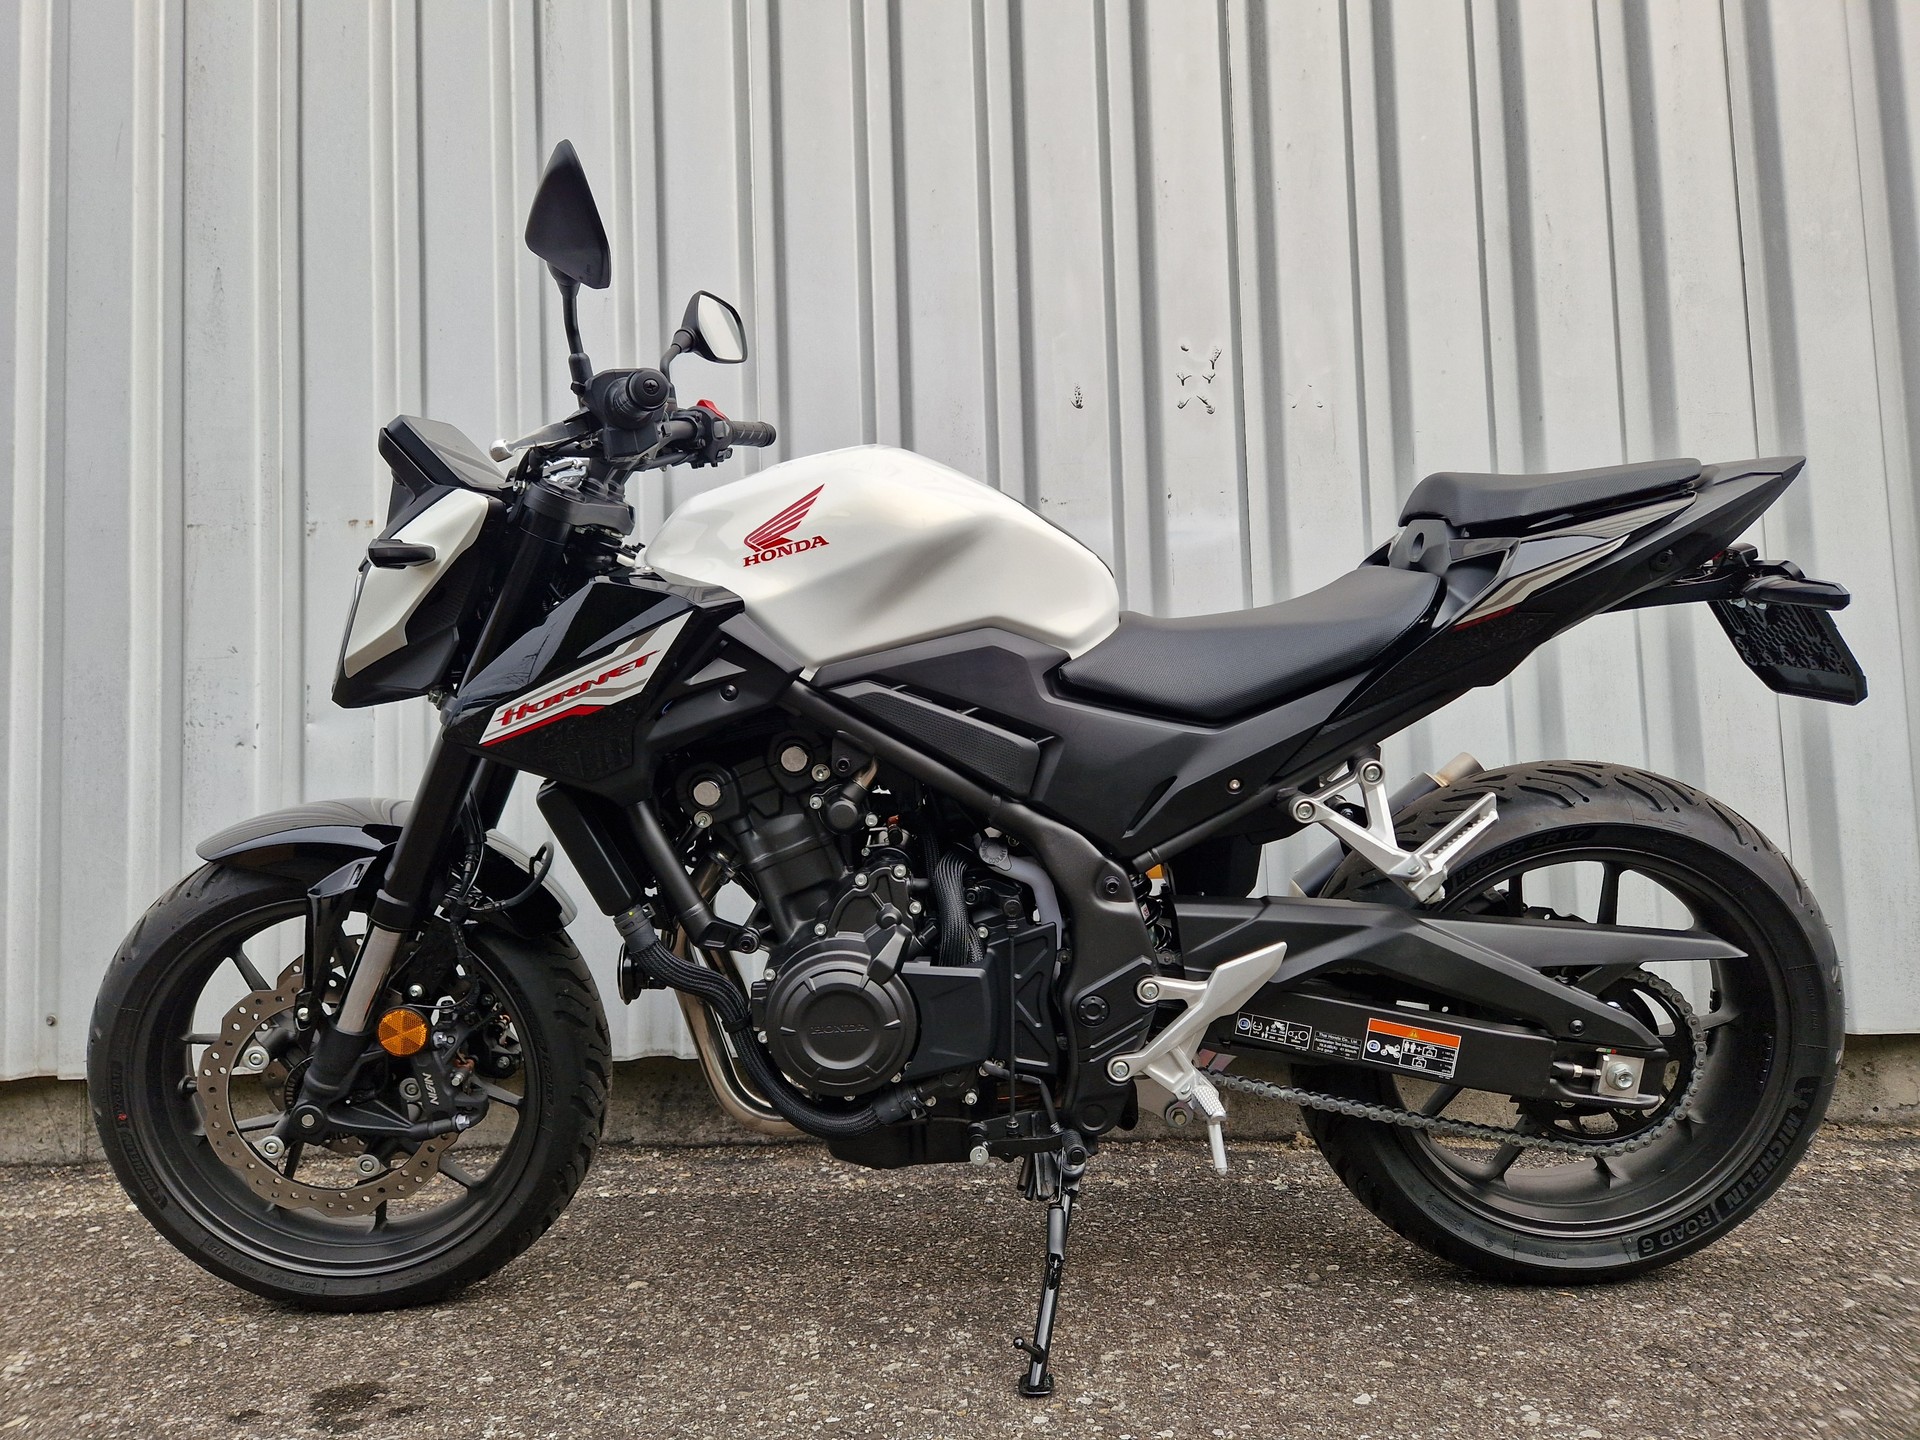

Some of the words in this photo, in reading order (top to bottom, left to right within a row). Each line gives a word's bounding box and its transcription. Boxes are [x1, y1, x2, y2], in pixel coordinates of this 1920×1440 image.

[743, 535, 829, 567] HONDA
[493, 649, 662, 726] HORNET
[810, 1024, 870, 1035] HONDA
[422, 1072, 440, 1105] NISSIN
[1723, 1112, 1802, 1211] MICHELIN
[1641, 1238, 1655, 1253] 6
[1659, 1213, 1713, 1247] ROAD
